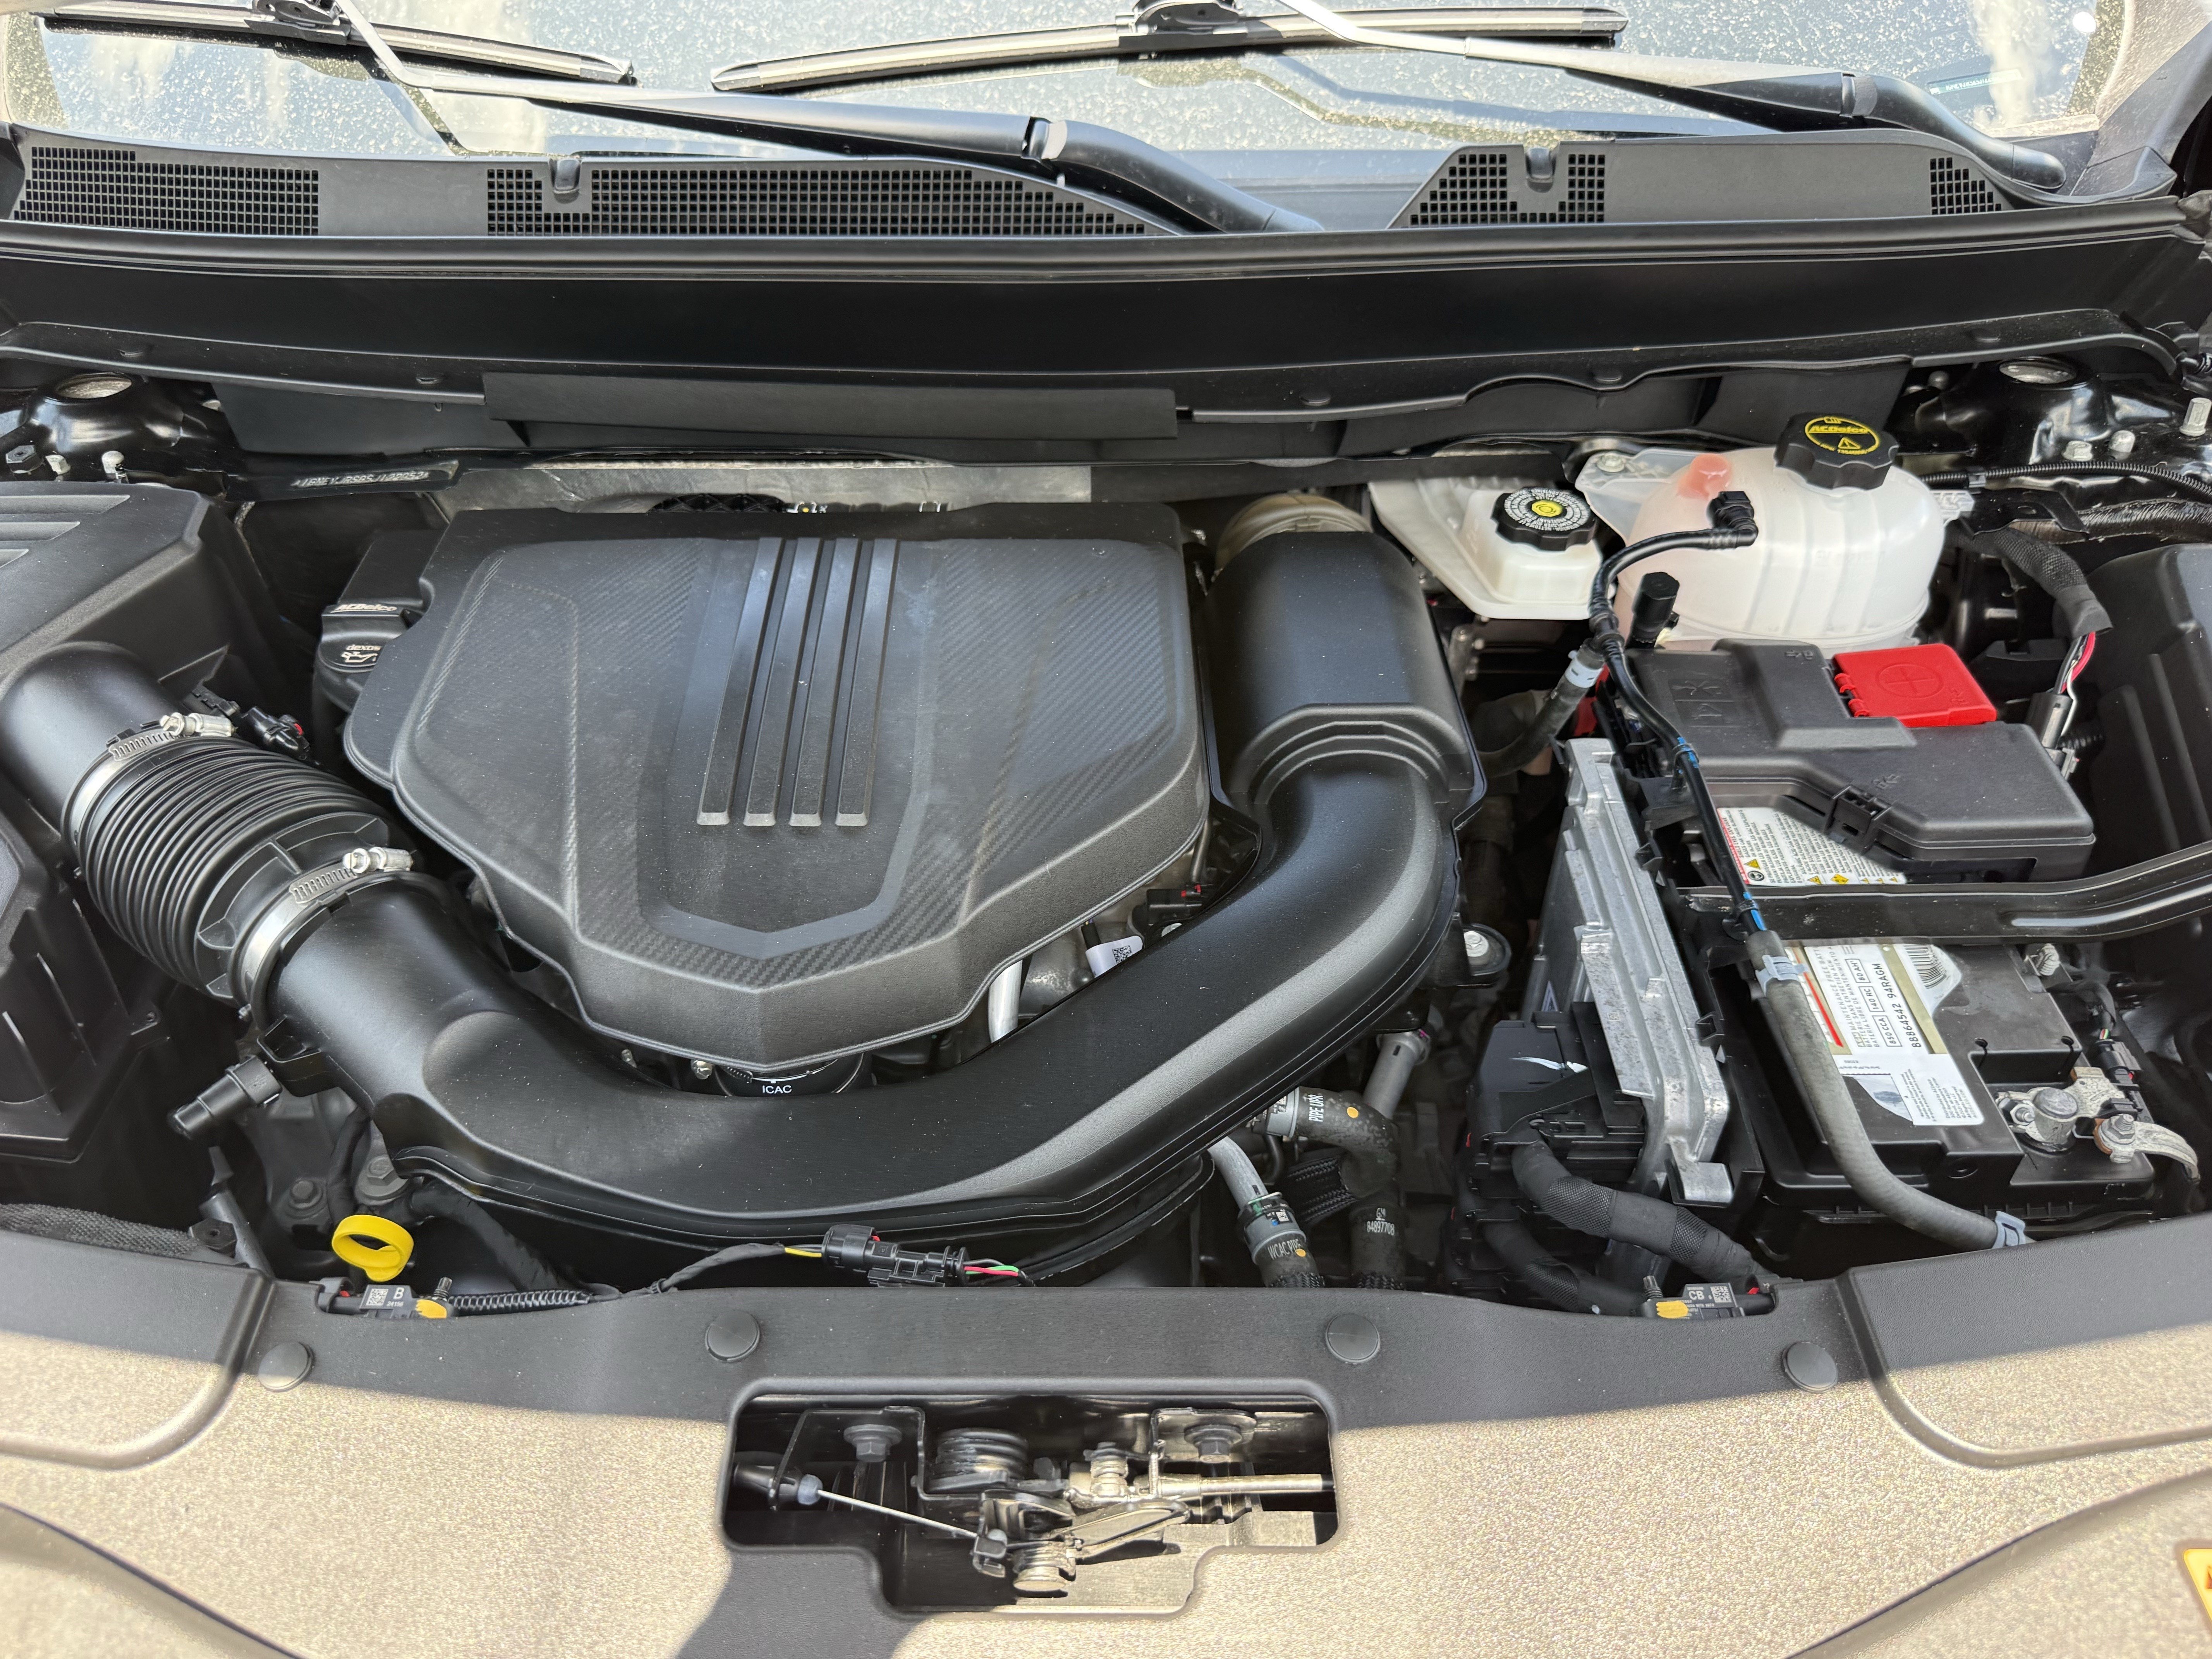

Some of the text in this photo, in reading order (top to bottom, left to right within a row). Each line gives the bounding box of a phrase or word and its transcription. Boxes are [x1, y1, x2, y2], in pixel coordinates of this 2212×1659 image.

[1811, 946, 1825, 963] BATT
[1822, 967, 1834, 982] FREE
[1829, 951, 1854, 995] MANTENIMIENTO
[1825, 960, 1872, 1047] BATTERIE SANS ENTRETIEN AGM
[1830, 984, 1856, 1030] MAINTENANCE
[1869, 998, 1879, 1009] 140
[1872, 963, 1922, 1047] 88864542 94RAGM
[1855, 1007, 1867, 1022] LIBRE
[1878, 1018, 1896, 1044] 850 CCA
[762, 1085, 792, 1094] ICAC
[1308, 1094, 1324, 1122] PIPE UPR
[1367, 1221, 1395, 1235] 84897708
[1267, 1242, 1290, 1260] WCAC
[393, 1287, 405, 1299] B
[1688, 1290, 1705, 1300] CB
